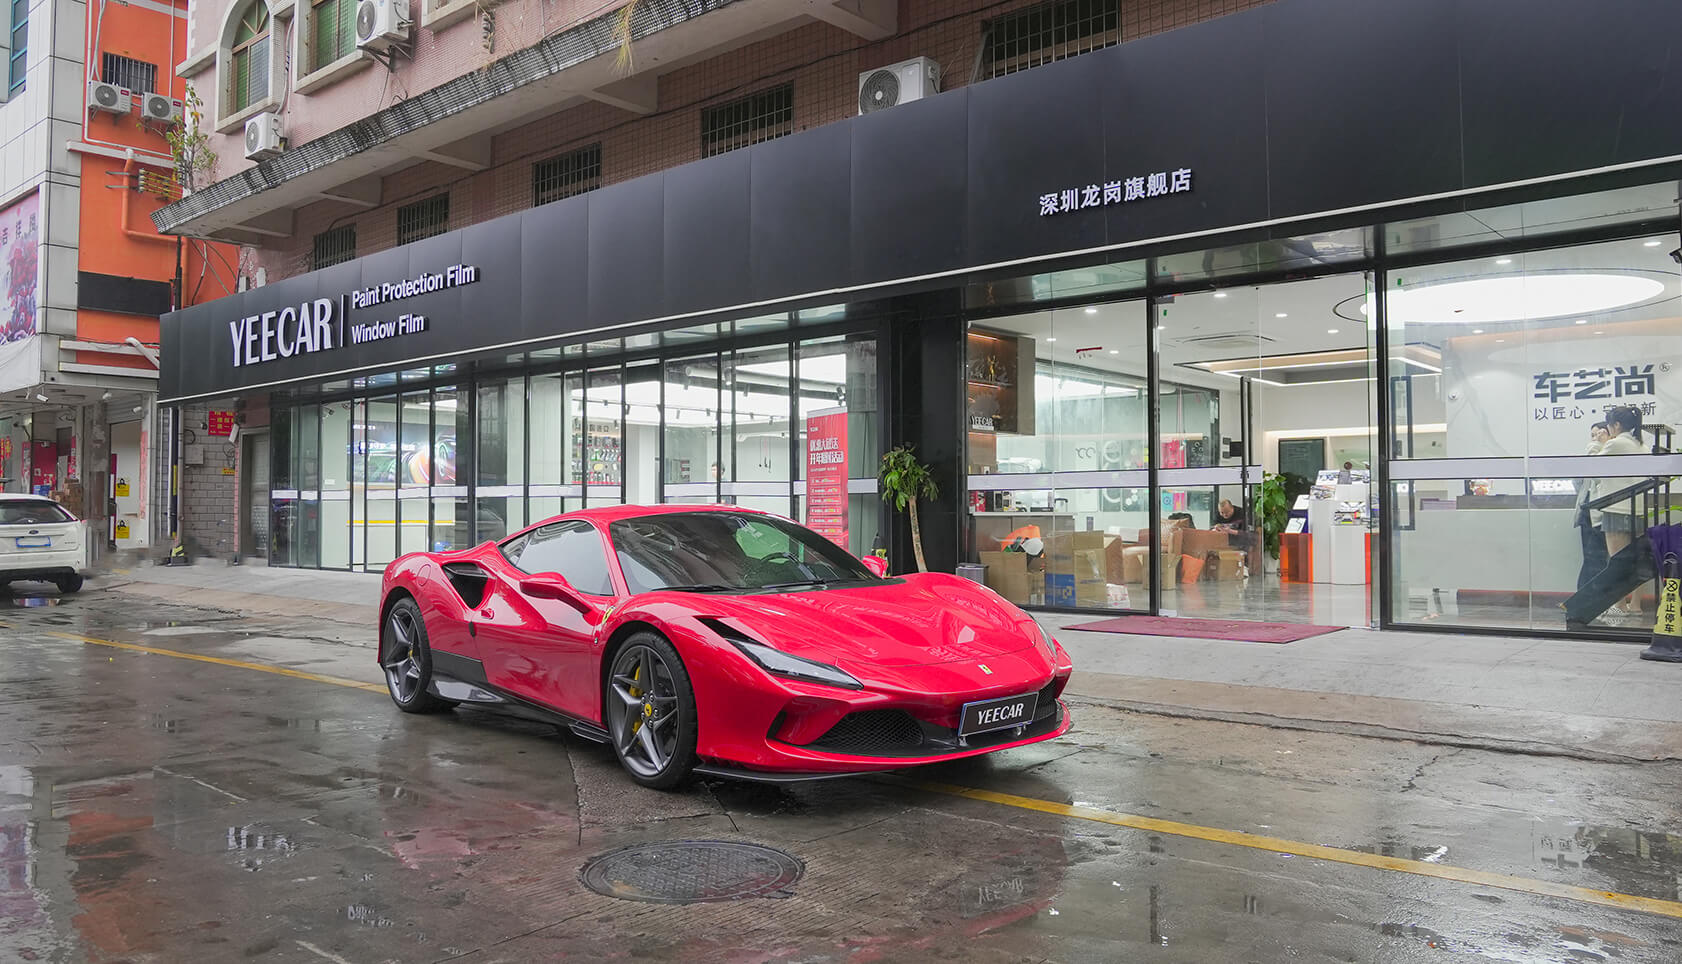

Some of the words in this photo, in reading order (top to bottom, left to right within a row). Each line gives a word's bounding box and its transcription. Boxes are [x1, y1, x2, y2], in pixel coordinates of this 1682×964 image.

[1039, 168, 1192, 216] 深圳龙岗旗舰店
[352, 287, 380, 309] Paint
[382, 272, 443, 301] Protection
[446, 264, 475, 288] Film
[229, 298, 334, 367] YEECAR
[351, 320, 396, 345] Window
[398, 313, 425, 335] Film
[1533, 364, 1656, 403] 车艺尚
[1664, 592, 1676, 632] 禁止停车
[978, 703, 1024, 725] YEECAR
